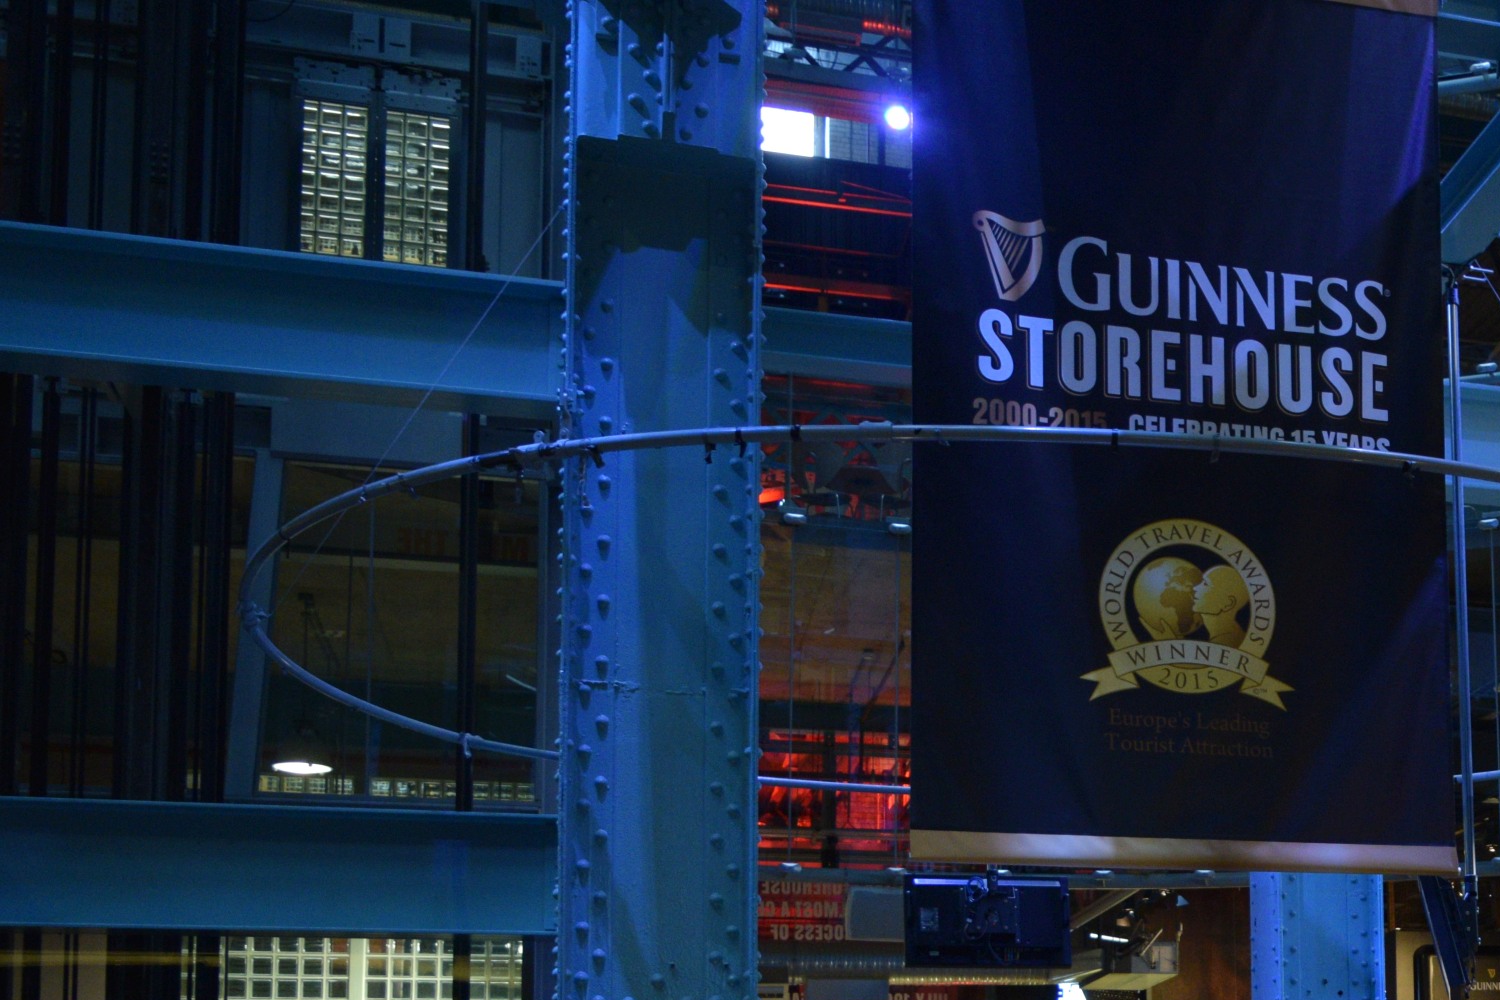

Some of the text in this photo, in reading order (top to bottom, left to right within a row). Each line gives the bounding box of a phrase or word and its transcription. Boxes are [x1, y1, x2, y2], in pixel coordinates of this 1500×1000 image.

[976, 307, 1390, 423] STOREHOUSE
[972, 397, 1107, 428] 2000-2015
[1104, 523, 1271, 647] WORLD TRAVEL AWARDS
[1126, 643, 1250, 674] WINNER
[1158, 667, 1219, 690] 2015
[1109, 707, 1272, 738] Europe's Leading
[1104, 732, 1273, 758] Tourist Attraction
